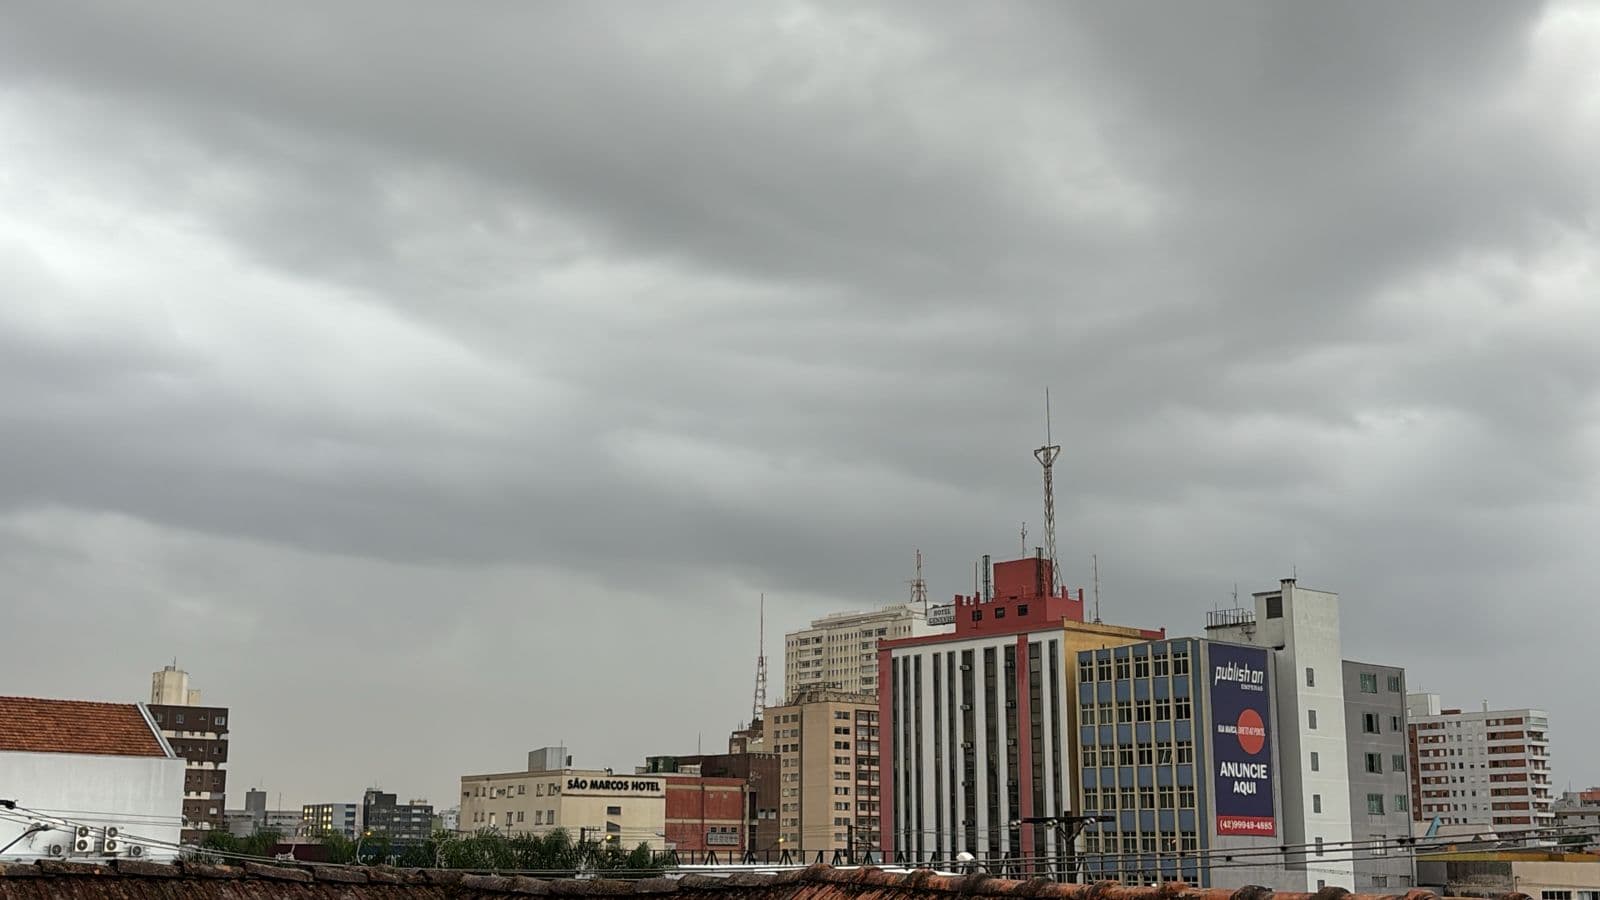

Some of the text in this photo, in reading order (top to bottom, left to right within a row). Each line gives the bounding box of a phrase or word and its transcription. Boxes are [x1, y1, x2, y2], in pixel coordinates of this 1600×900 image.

[933, 608, 951, 617] HOTEL
[1214, 661, 1264, 686] publish on
[1220, 761, 1268, 779] ANUNCIE
[567, 777, 661, 791] SÃO MARCOS HOTEL
[1233, 780, 1257, 796] AQUI
